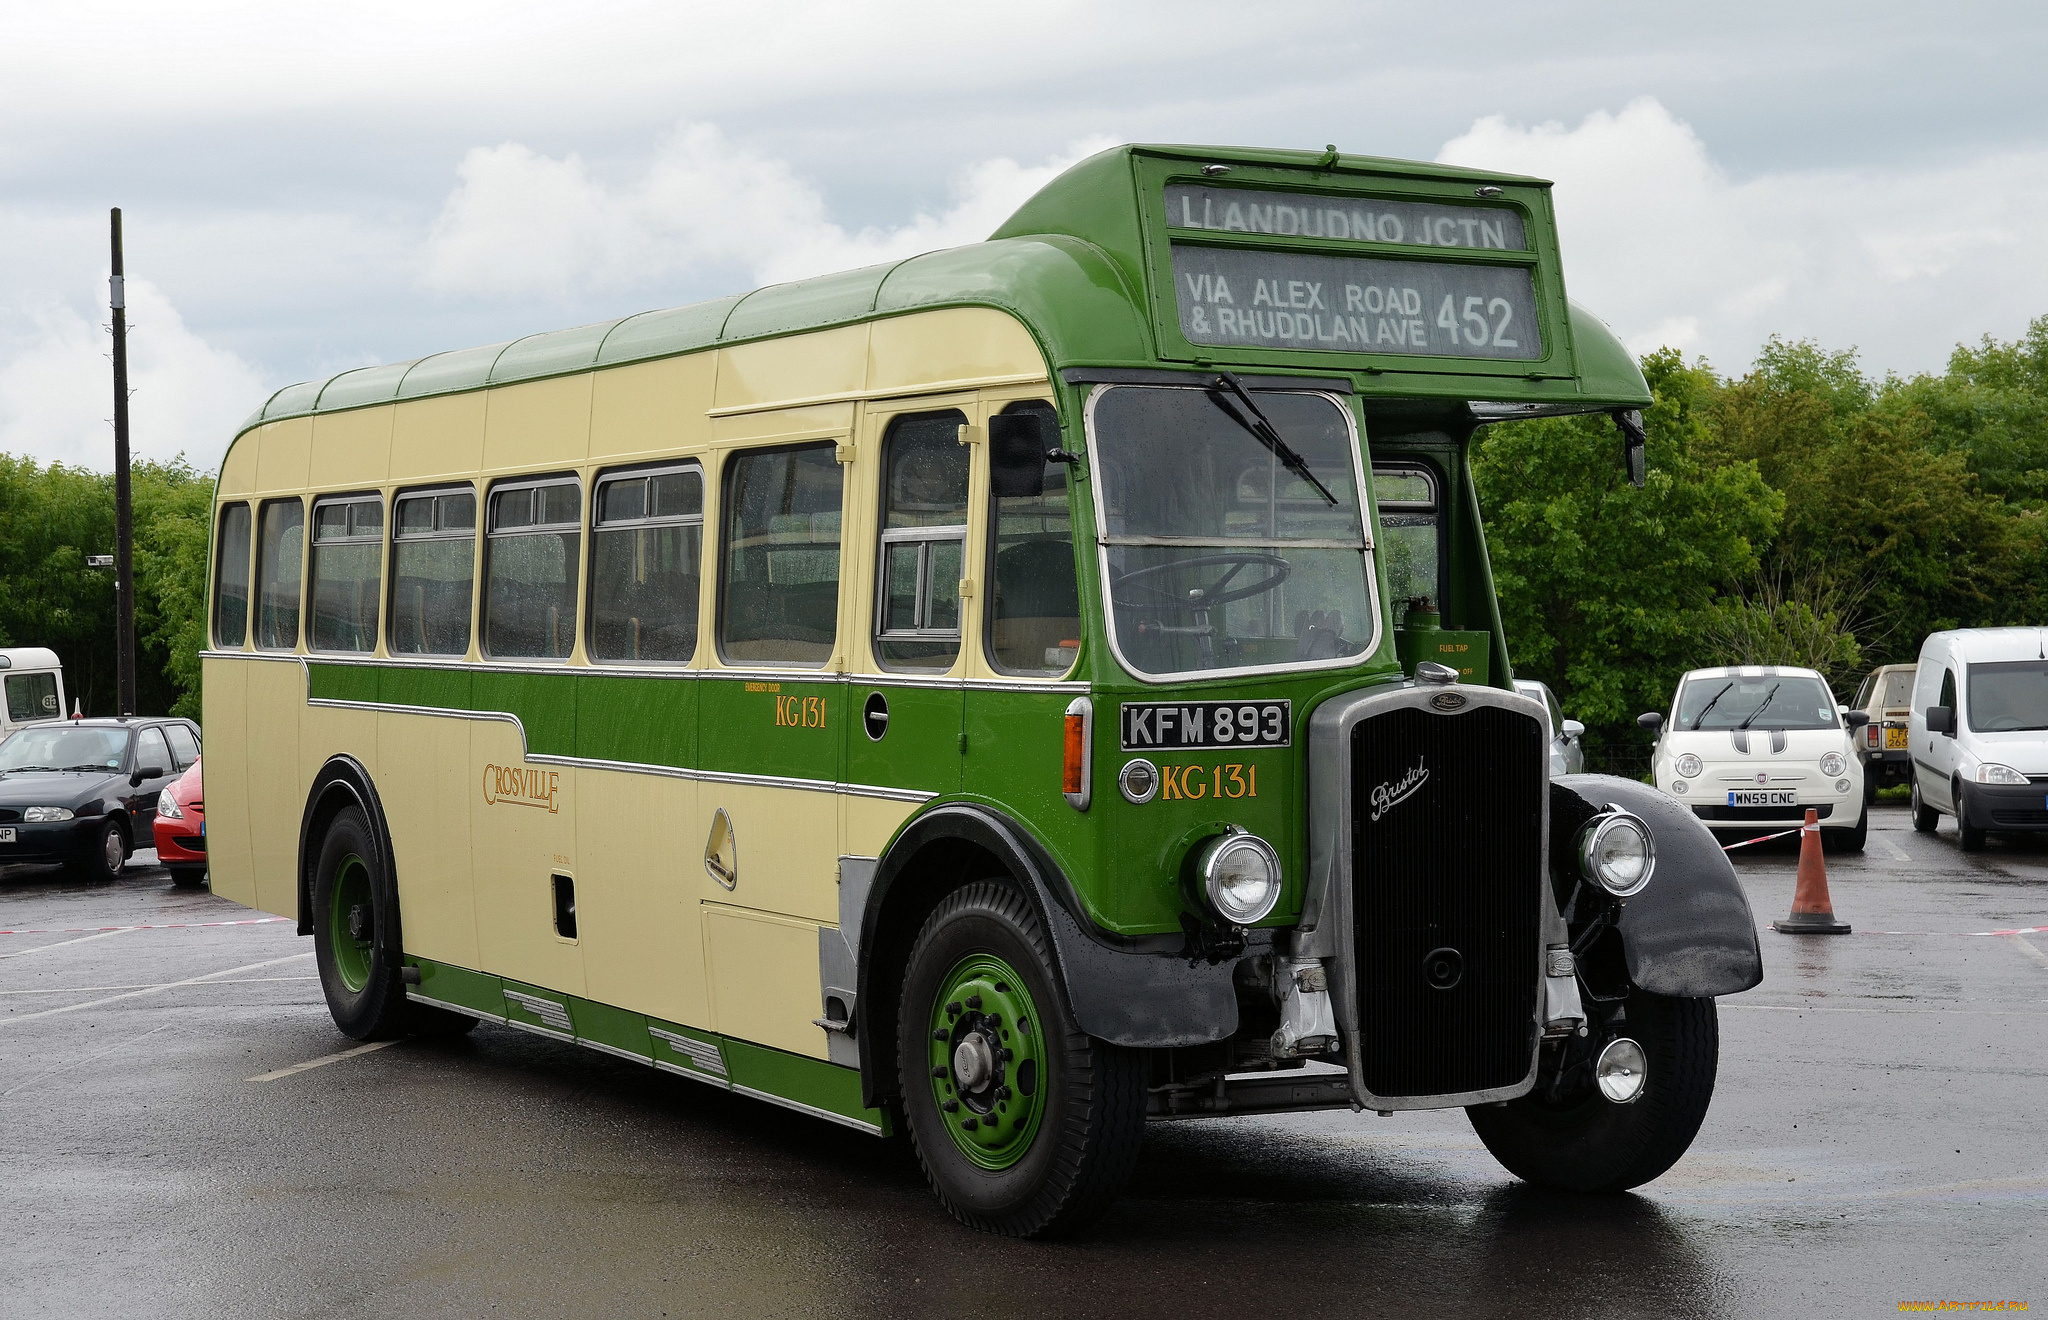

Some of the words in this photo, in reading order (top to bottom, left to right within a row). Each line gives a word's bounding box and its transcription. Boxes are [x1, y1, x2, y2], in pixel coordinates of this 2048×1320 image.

[1181, 196, 1404, 243] LLANDUDNO
[1415, 216, 1506, 249] JCTN
[1185, 273, 1233, 304] VIA
[1253, 279, 1325, 310] ALEX
[1345, 284, 1421, 316] ROAD
[1192, 306, 1212, 334] &
[1217, 308, 1370, 344] RHUDDLAN
[1377, 318, 1427, 347] AVE
[1437, 294, 1518, 348] 452
[1439, 644, 1455, 652] FUEL
[1456, 644, 1469, 652] TAP
[745, 682, 767, 692] EMERGENCY
[768, 683, 781, 693] DOOR
[775, 695, 799, 727] KG
[801, 696, 826, 728] 131
[1130, 707, 1204, 745] KFM
[1213, 706, 1283, 743] 893
[482, 763, 560, 814] CROSVILLE
[1162, 765, 1207, 800] KG
[1212, 764, 1258, 799] 131
[1370, 754, 1430, 821] Bristol
[1736, 793, 1767, 804] WN59
[1771, 793, 1794, 803] CNC
